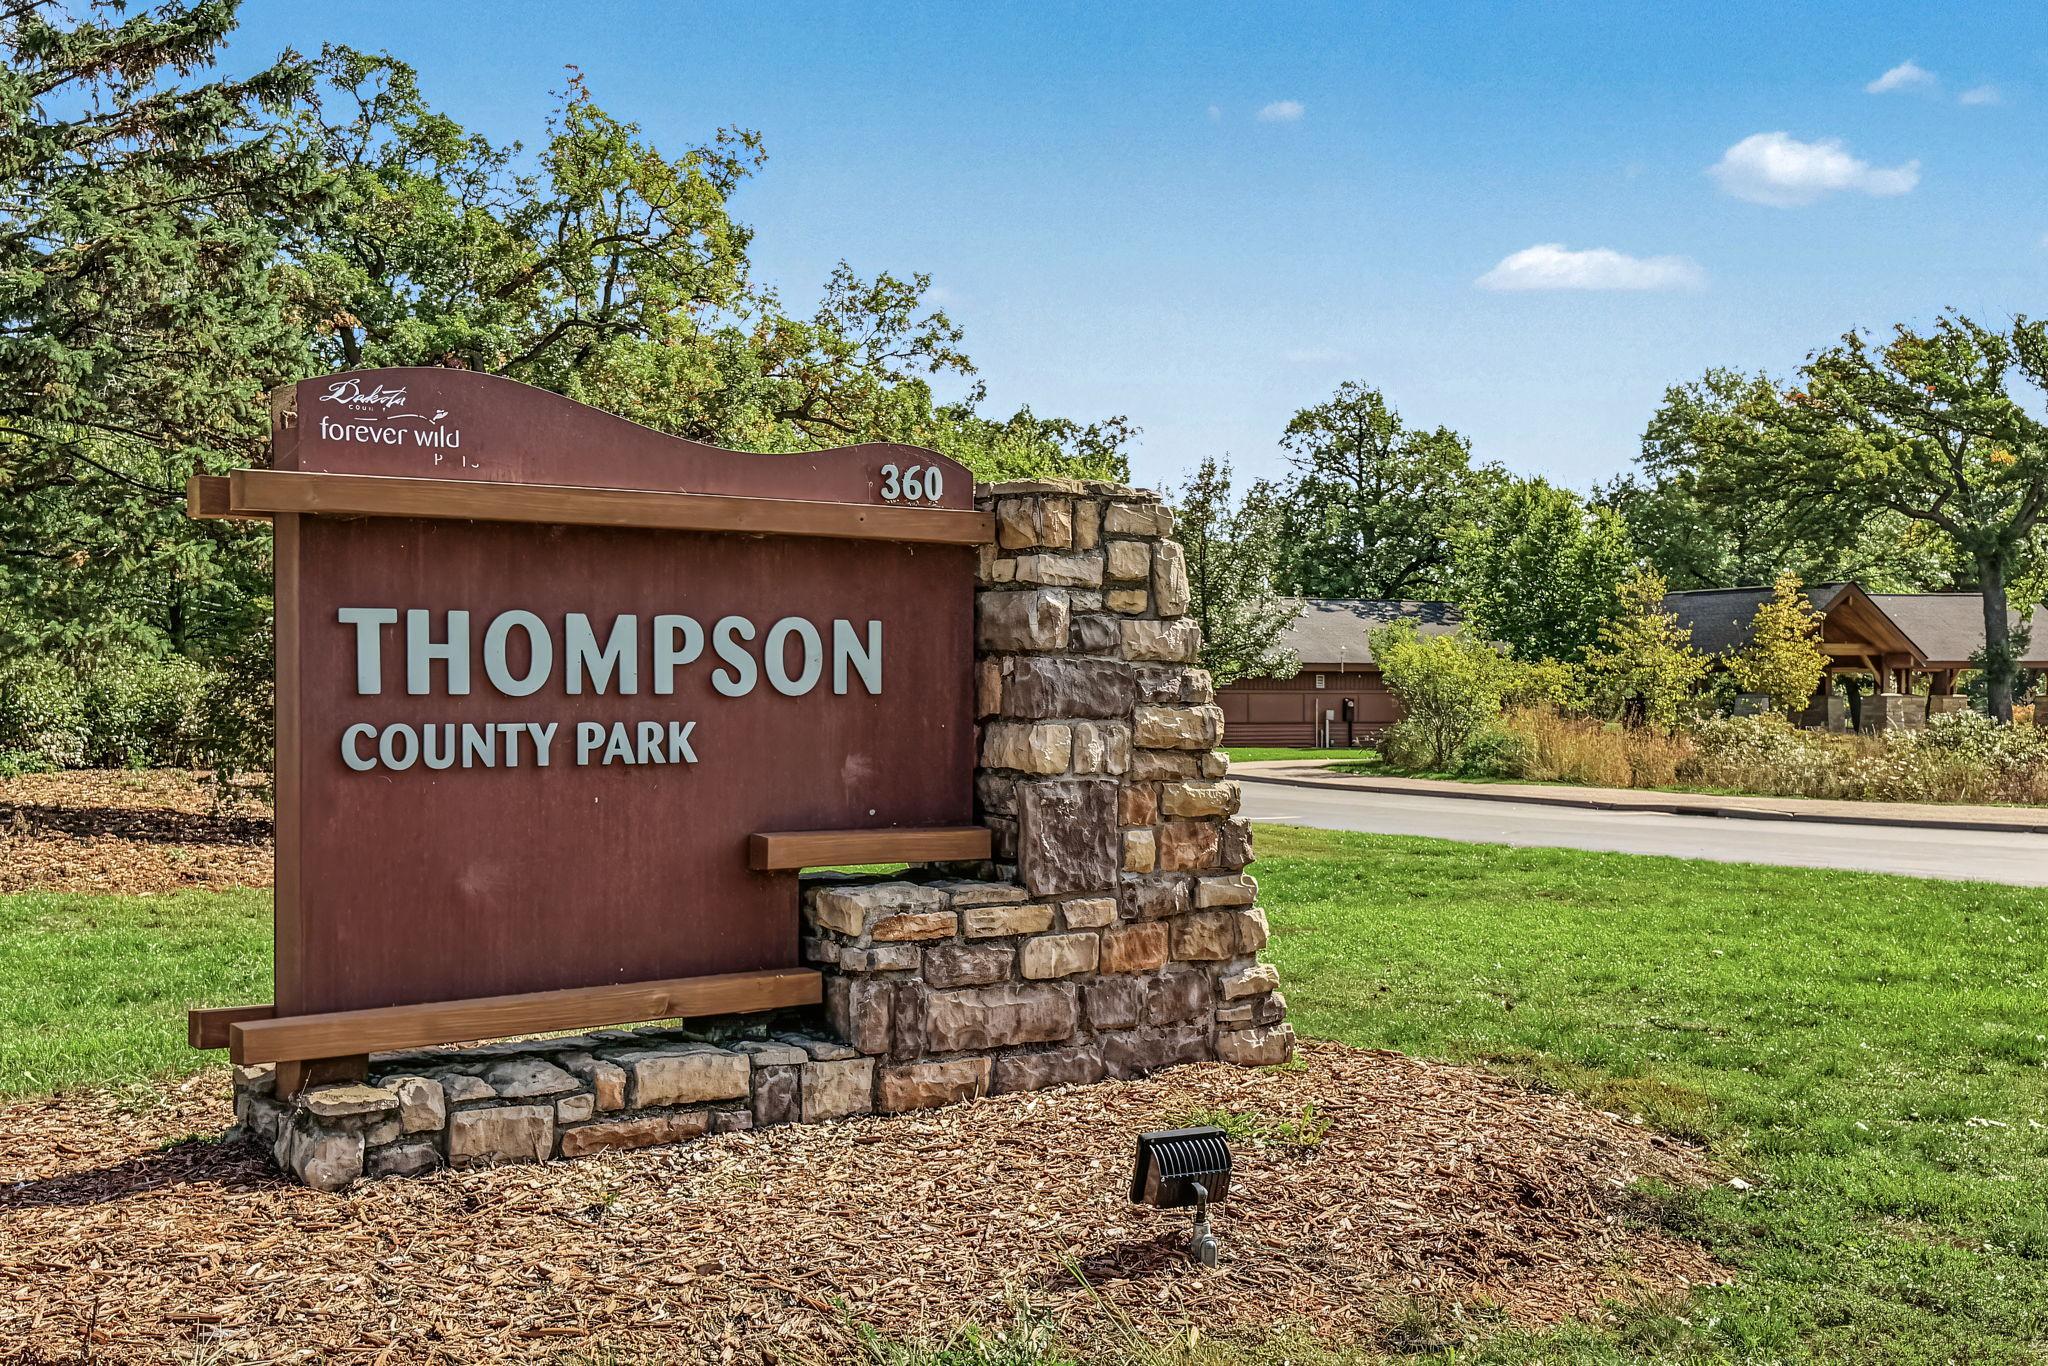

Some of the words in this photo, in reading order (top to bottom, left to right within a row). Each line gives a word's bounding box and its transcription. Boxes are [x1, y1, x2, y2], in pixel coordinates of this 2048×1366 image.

[319, 378, 407, 408] Dakota
[319, 415, 408, 445] forever
[414, 425, 460, 448] wild
[880, 463, 943, 501] 360
[338, 607, 882, 697] THOMPSON
[341, 722, 558, 771] COUNTY
[577, 721, 698, 766] PARK
